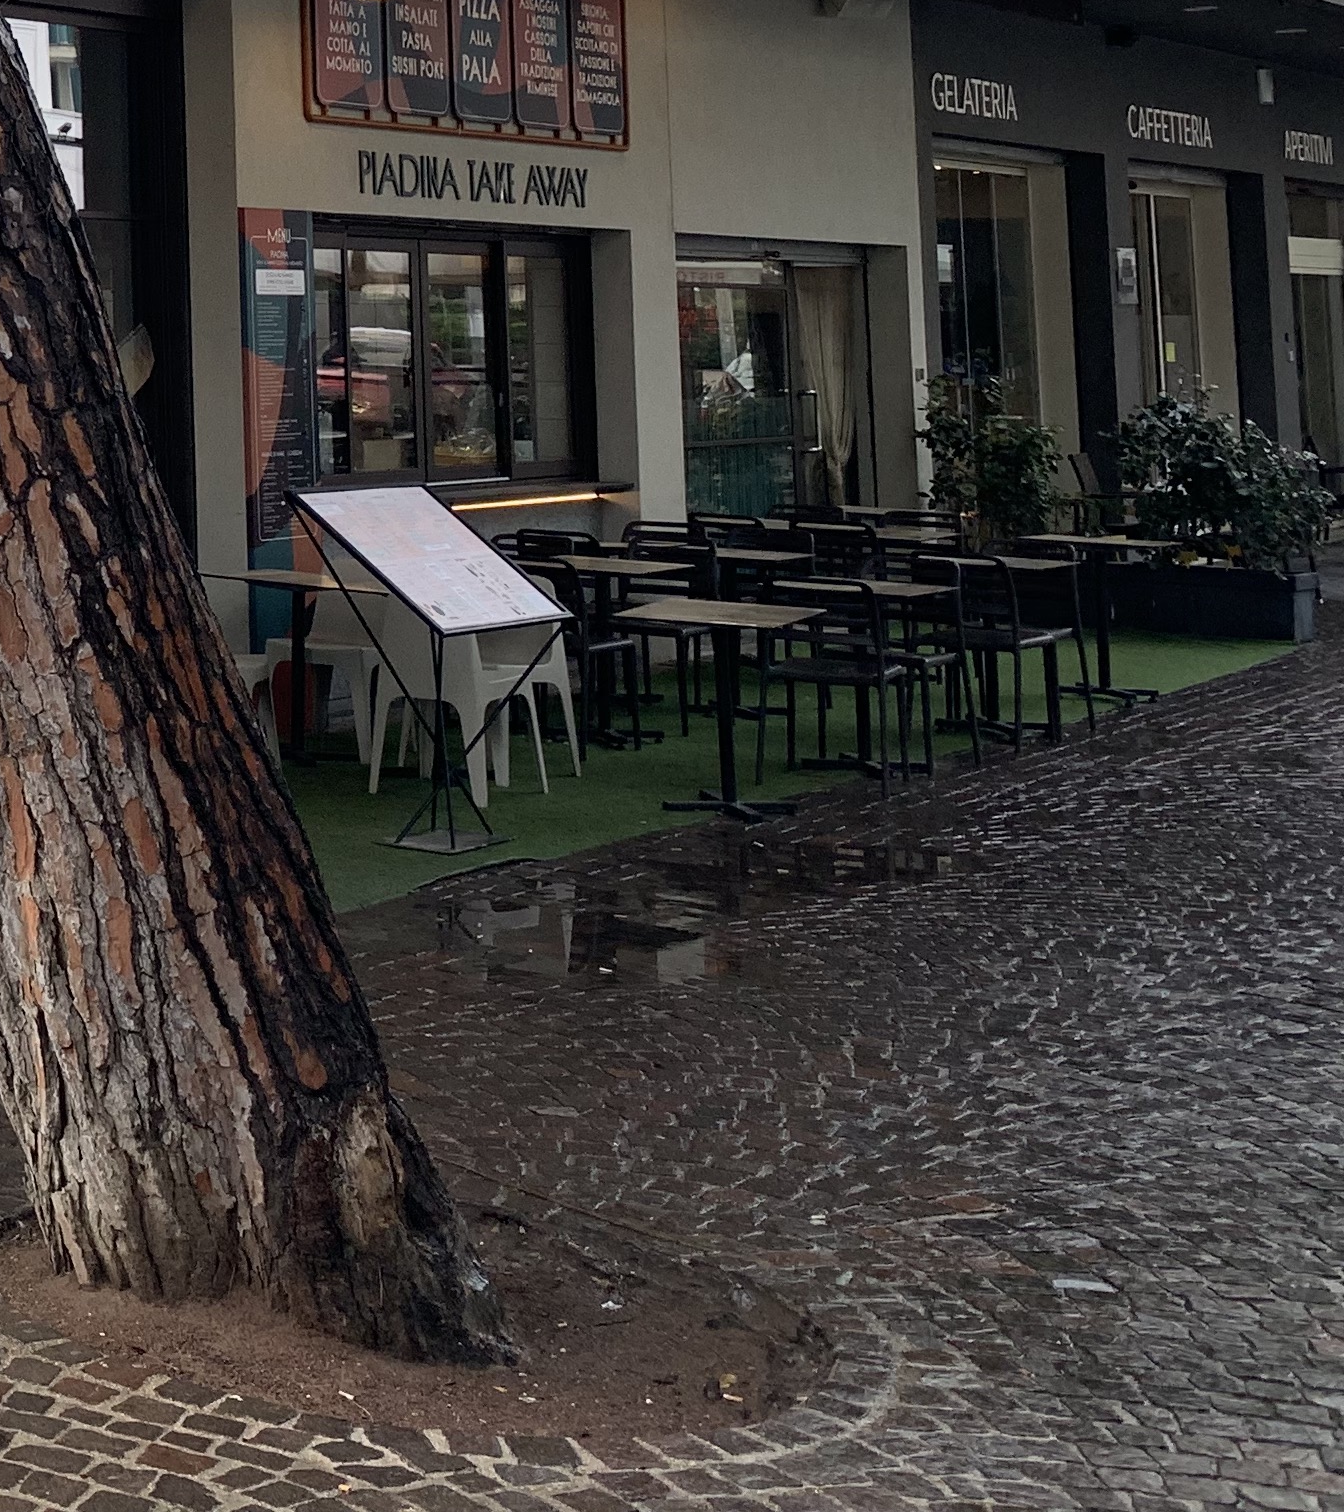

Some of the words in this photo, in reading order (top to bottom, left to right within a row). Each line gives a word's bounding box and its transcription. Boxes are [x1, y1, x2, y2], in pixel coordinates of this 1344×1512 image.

[328, 0, 354, 18] FATTA
[358, 7, 366, 19] A
[395, 4, 438, 28] INSALATE
[330, 19, 359, 37] MANO
[532, 15, 557, 31] NOSTRI
[327, 37, 356, 55] COTTA
[358, 43, 370, 56] AL
[401, 31, 432, 52] PASTA
[469, 29, 493, 47] ALLA
[524, 30, 558, 48] CASSONI
[530, 47, 552, 63] DELLA
[579, 55, 610, 71] PASSIONE
[326, 56, 373, 75] MOMENTO
[392, 55, 417, 76] SUSHI
[462, 53, 502, 86] PALA
[520, 62, 564, 82] TRADIZIONE
[526, 80, 558, 98] RIMINESE
[579, 71, 618, 89] TRADIZIONE
[576, 88, 621, 106] ROMAGNOLA
[931, 72, 1018, 121] GELATERIA
[1127, 104, 1214, 149] CAFFETTERIA
[358, 149, 461, 200] PIADINA
[466, 159, 516, 204] TAKE
[522, 164, 589, 208] AWAY
[267, 227, 291, 243] MENU
